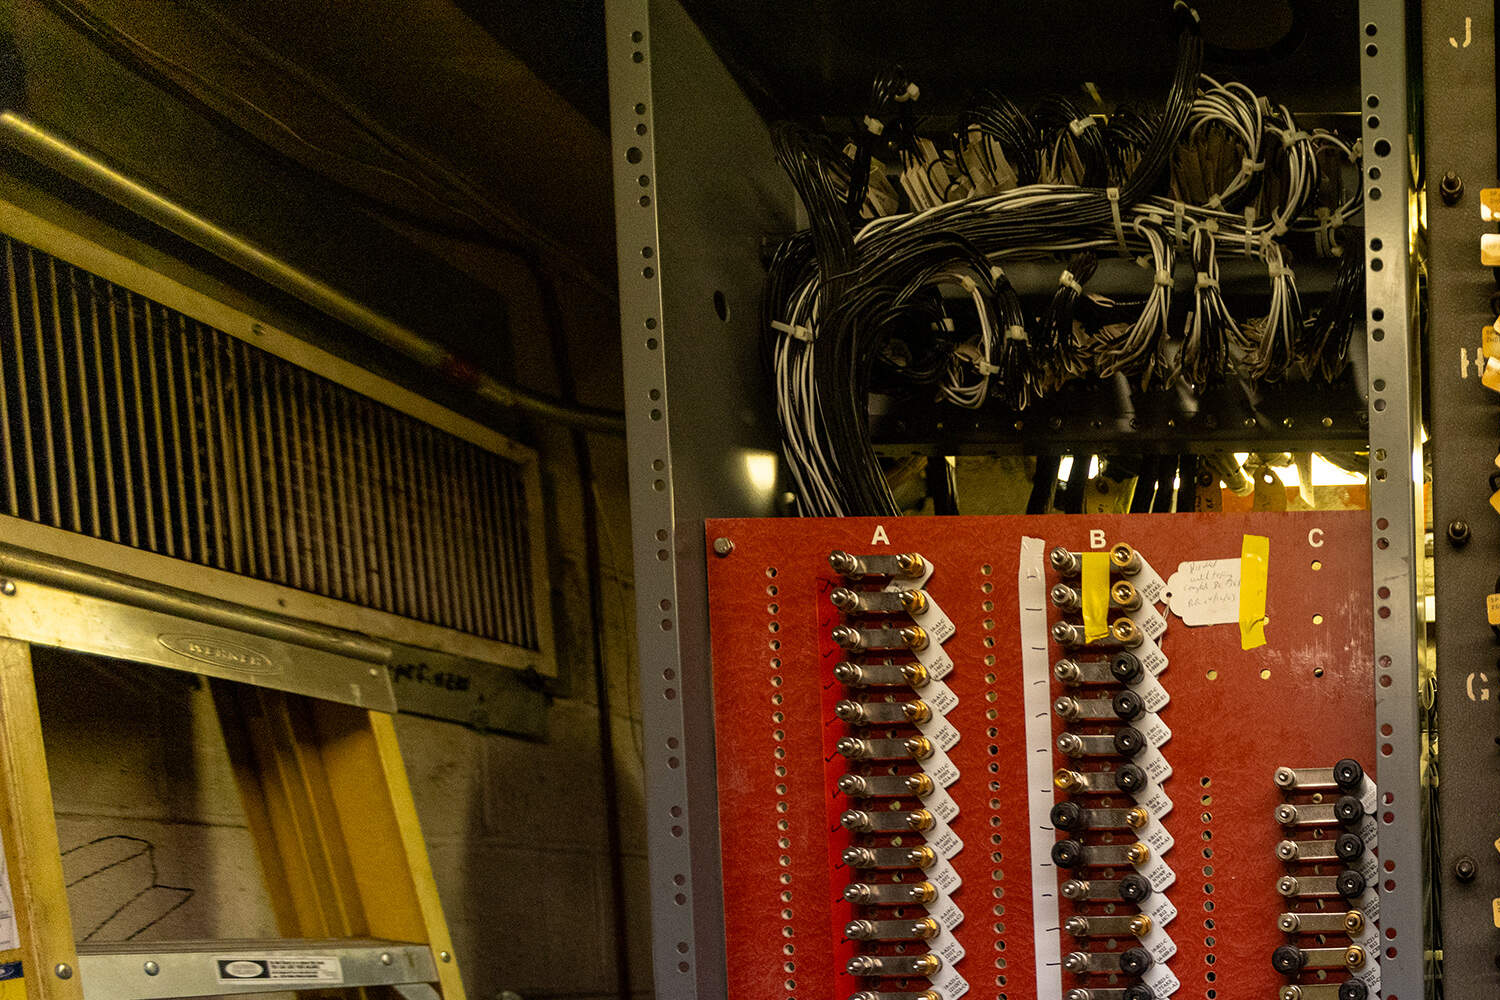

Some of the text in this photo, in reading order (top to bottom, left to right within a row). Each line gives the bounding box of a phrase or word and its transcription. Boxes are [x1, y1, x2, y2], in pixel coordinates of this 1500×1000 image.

[1449, 17, 1471, 48] J
[1461, 347, 1485, 378] H
[871, 526, 890, 545] A
[1090, 530, 1107, 549] B
[1309, 528, 1324, 548] C
[1467, 672, 1489, 702] G
